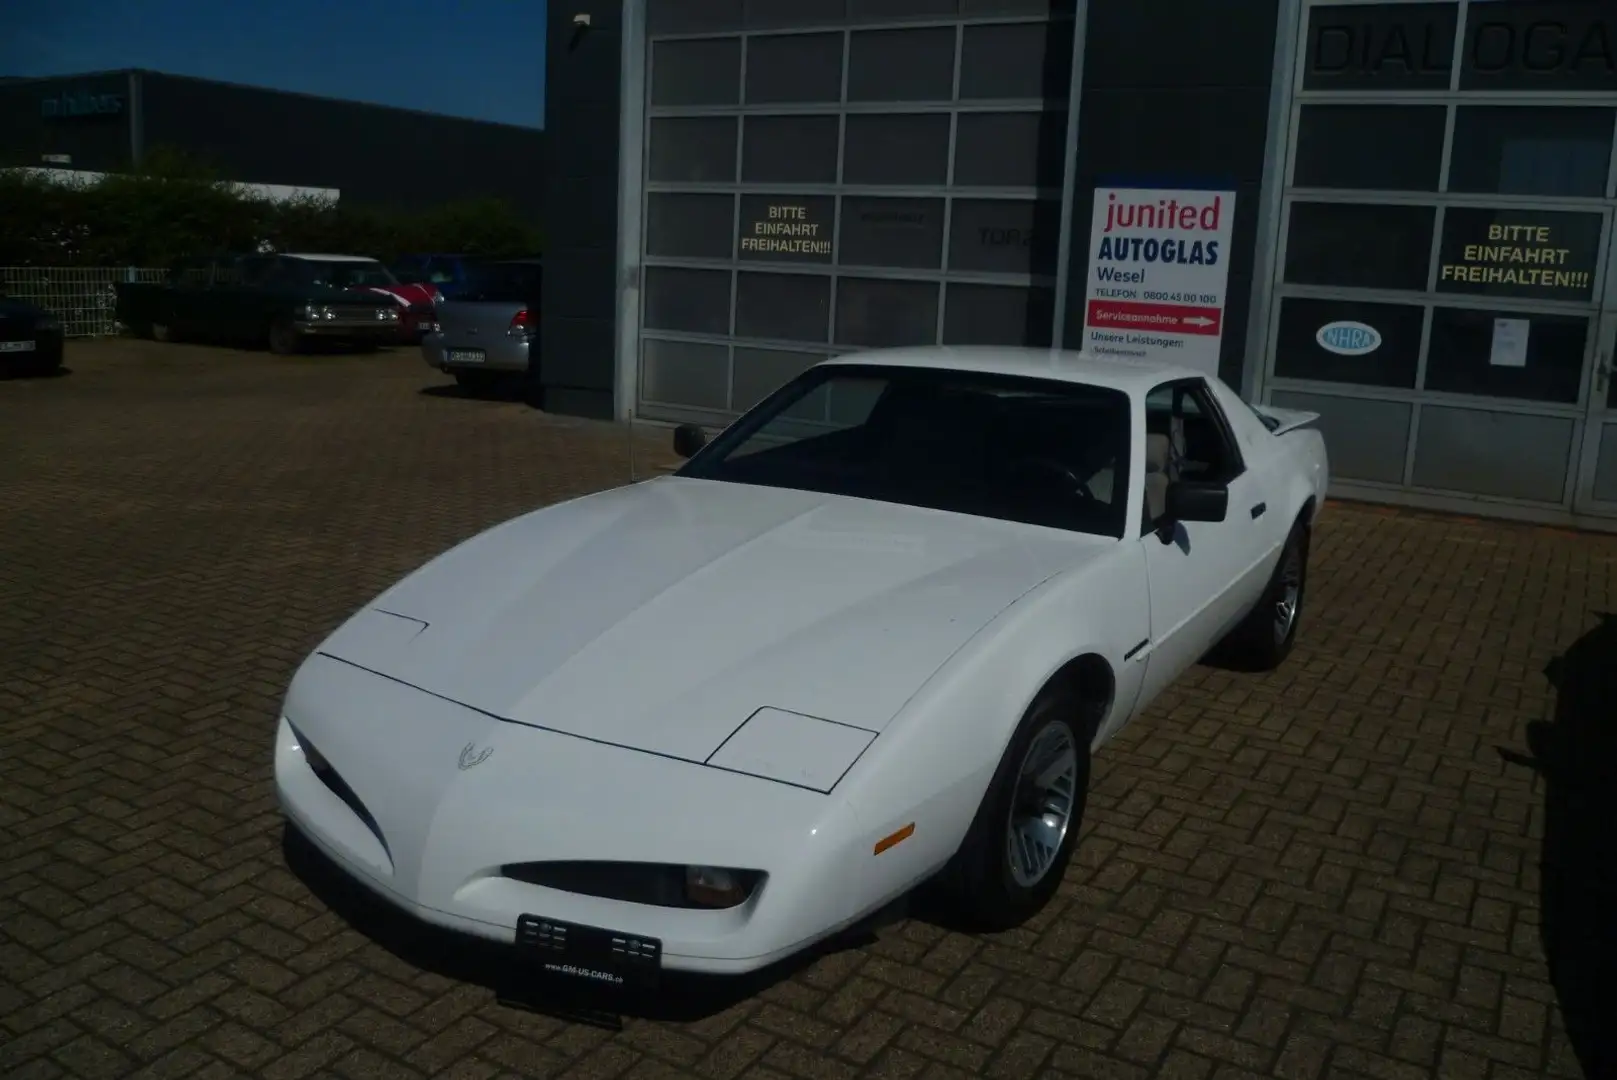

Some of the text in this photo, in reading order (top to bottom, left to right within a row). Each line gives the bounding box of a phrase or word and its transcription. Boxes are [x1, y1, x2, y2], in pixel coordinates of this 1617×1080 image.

[769, 205, 807, 220] BITTE
[1104, 193, 1221, 233] junited
[755, 221, 819, 237] EINFAHRT
[1488, 224, 1552, 243] BITTE
[741, 237, 831, 254] FREIHALTEN!!!
[1098, 236, 1219, 265] AUTOGLAS
[1463, 244, 1571, 265] EINFAHRT
[1097, 266, 1146, 284] Wesel
[1440, 264, 1590, 288] FREIHALTEN!!!
[1091, 331, 1125, 343] Unsere
[1326, 327, 1373, 349] NHRA
